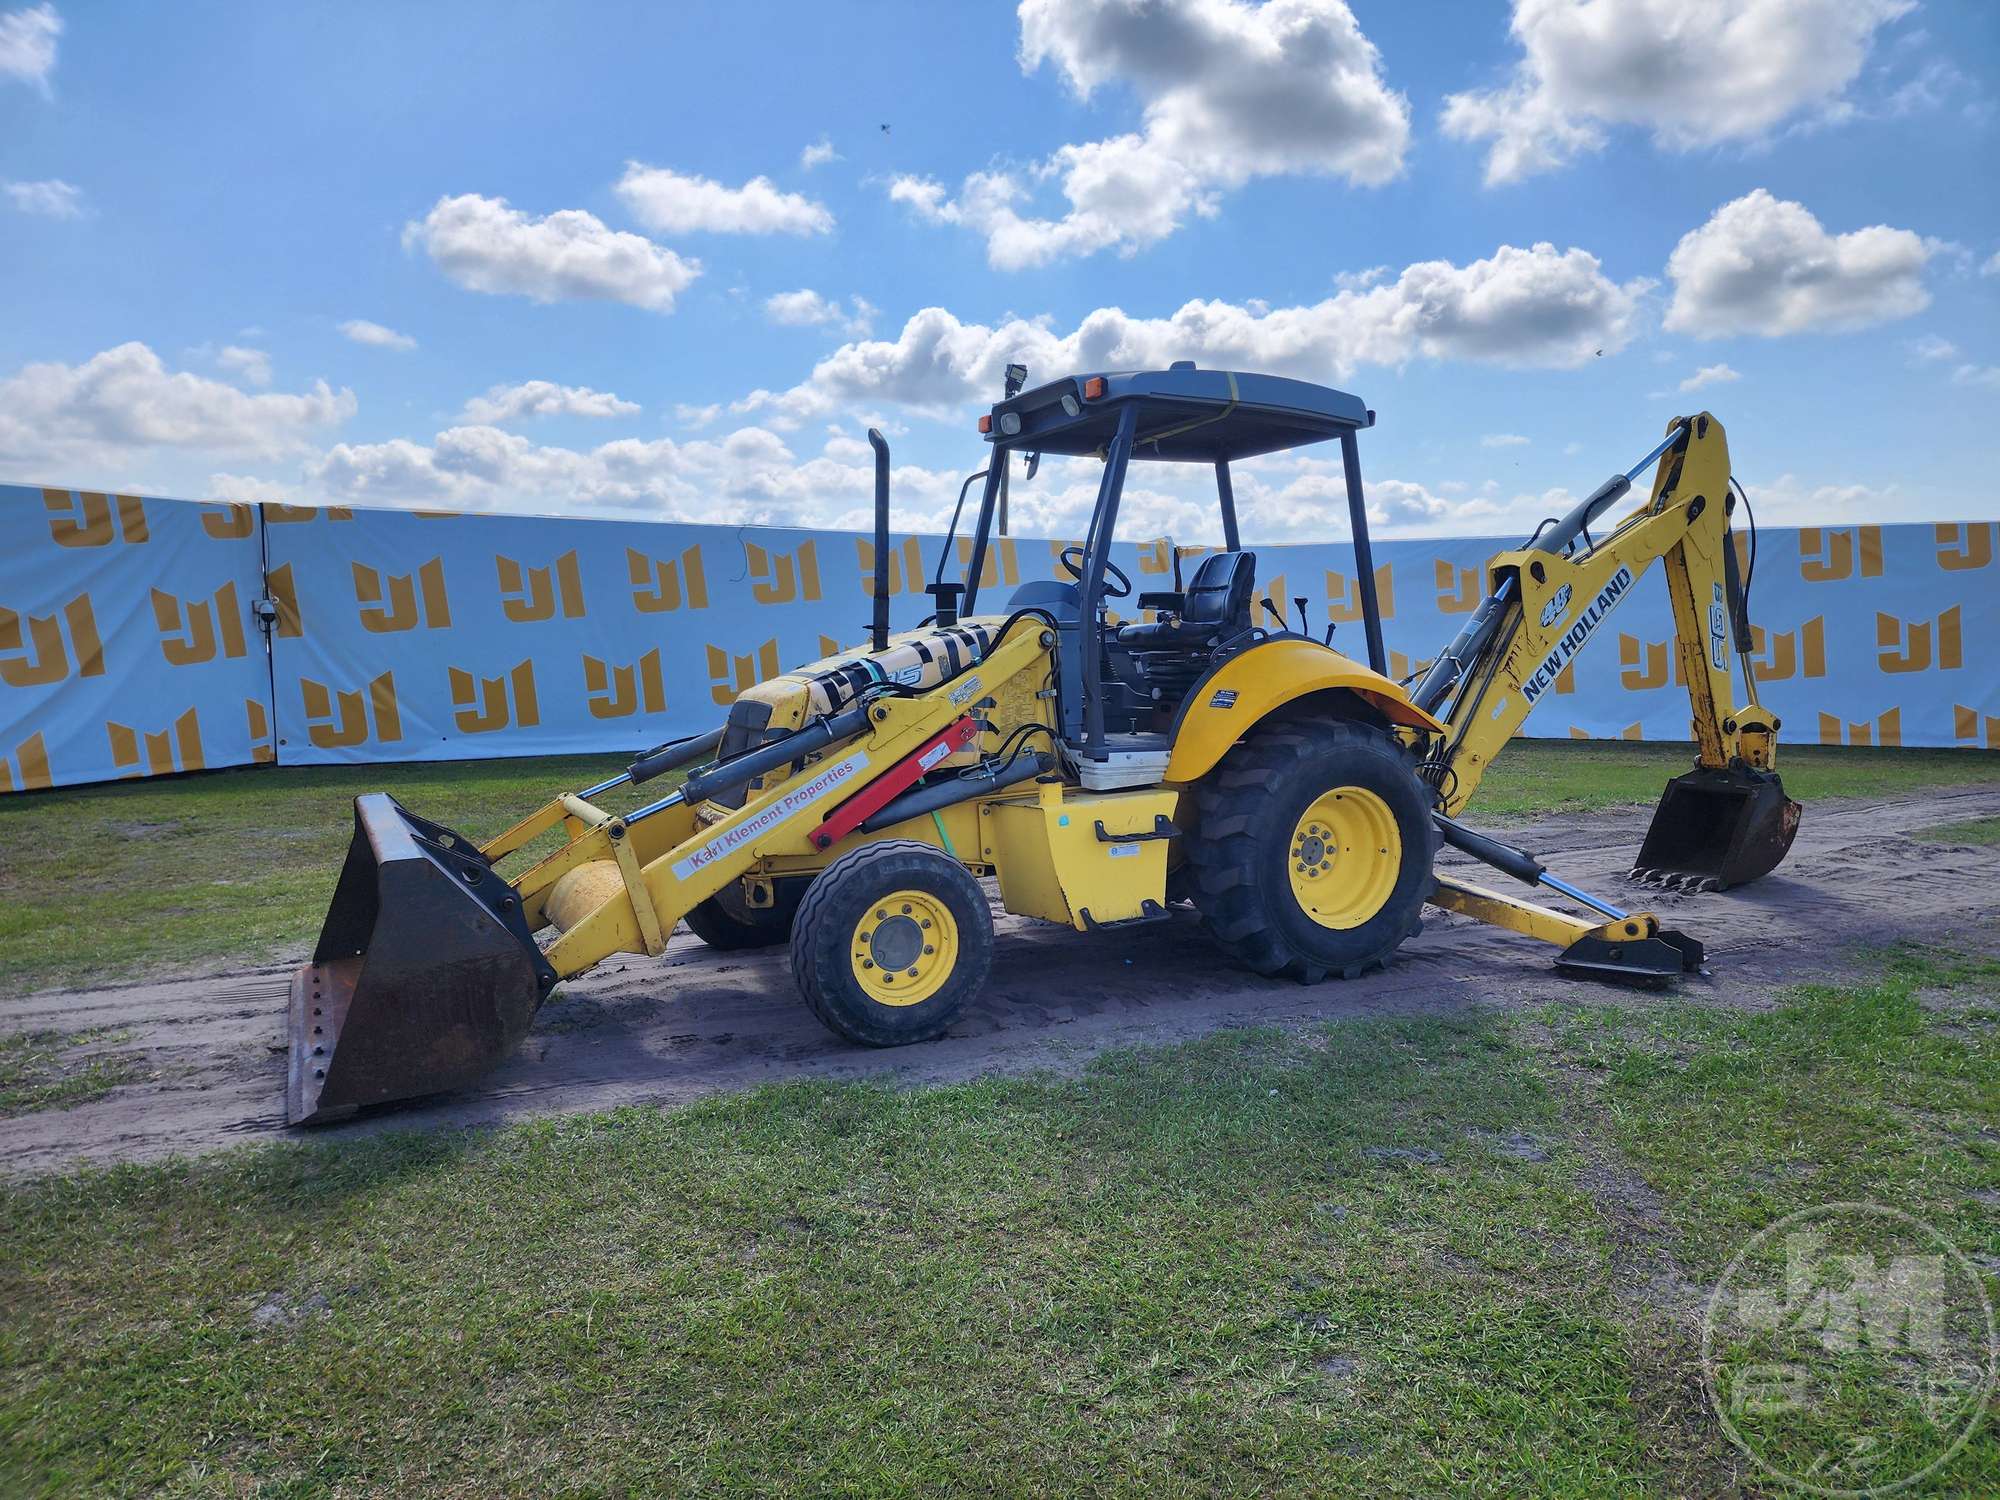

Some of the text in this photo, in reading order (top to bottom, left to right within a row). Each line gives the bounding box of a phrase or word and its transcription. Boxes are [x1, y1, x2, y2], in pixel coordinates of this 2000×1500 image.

[1522, 650, 1562, 702] NEW
[1563, 567, 1632, 656] HOLLAND
[725, 805, 783, 847] Klement
[784, 761, 854, 809] Properties
